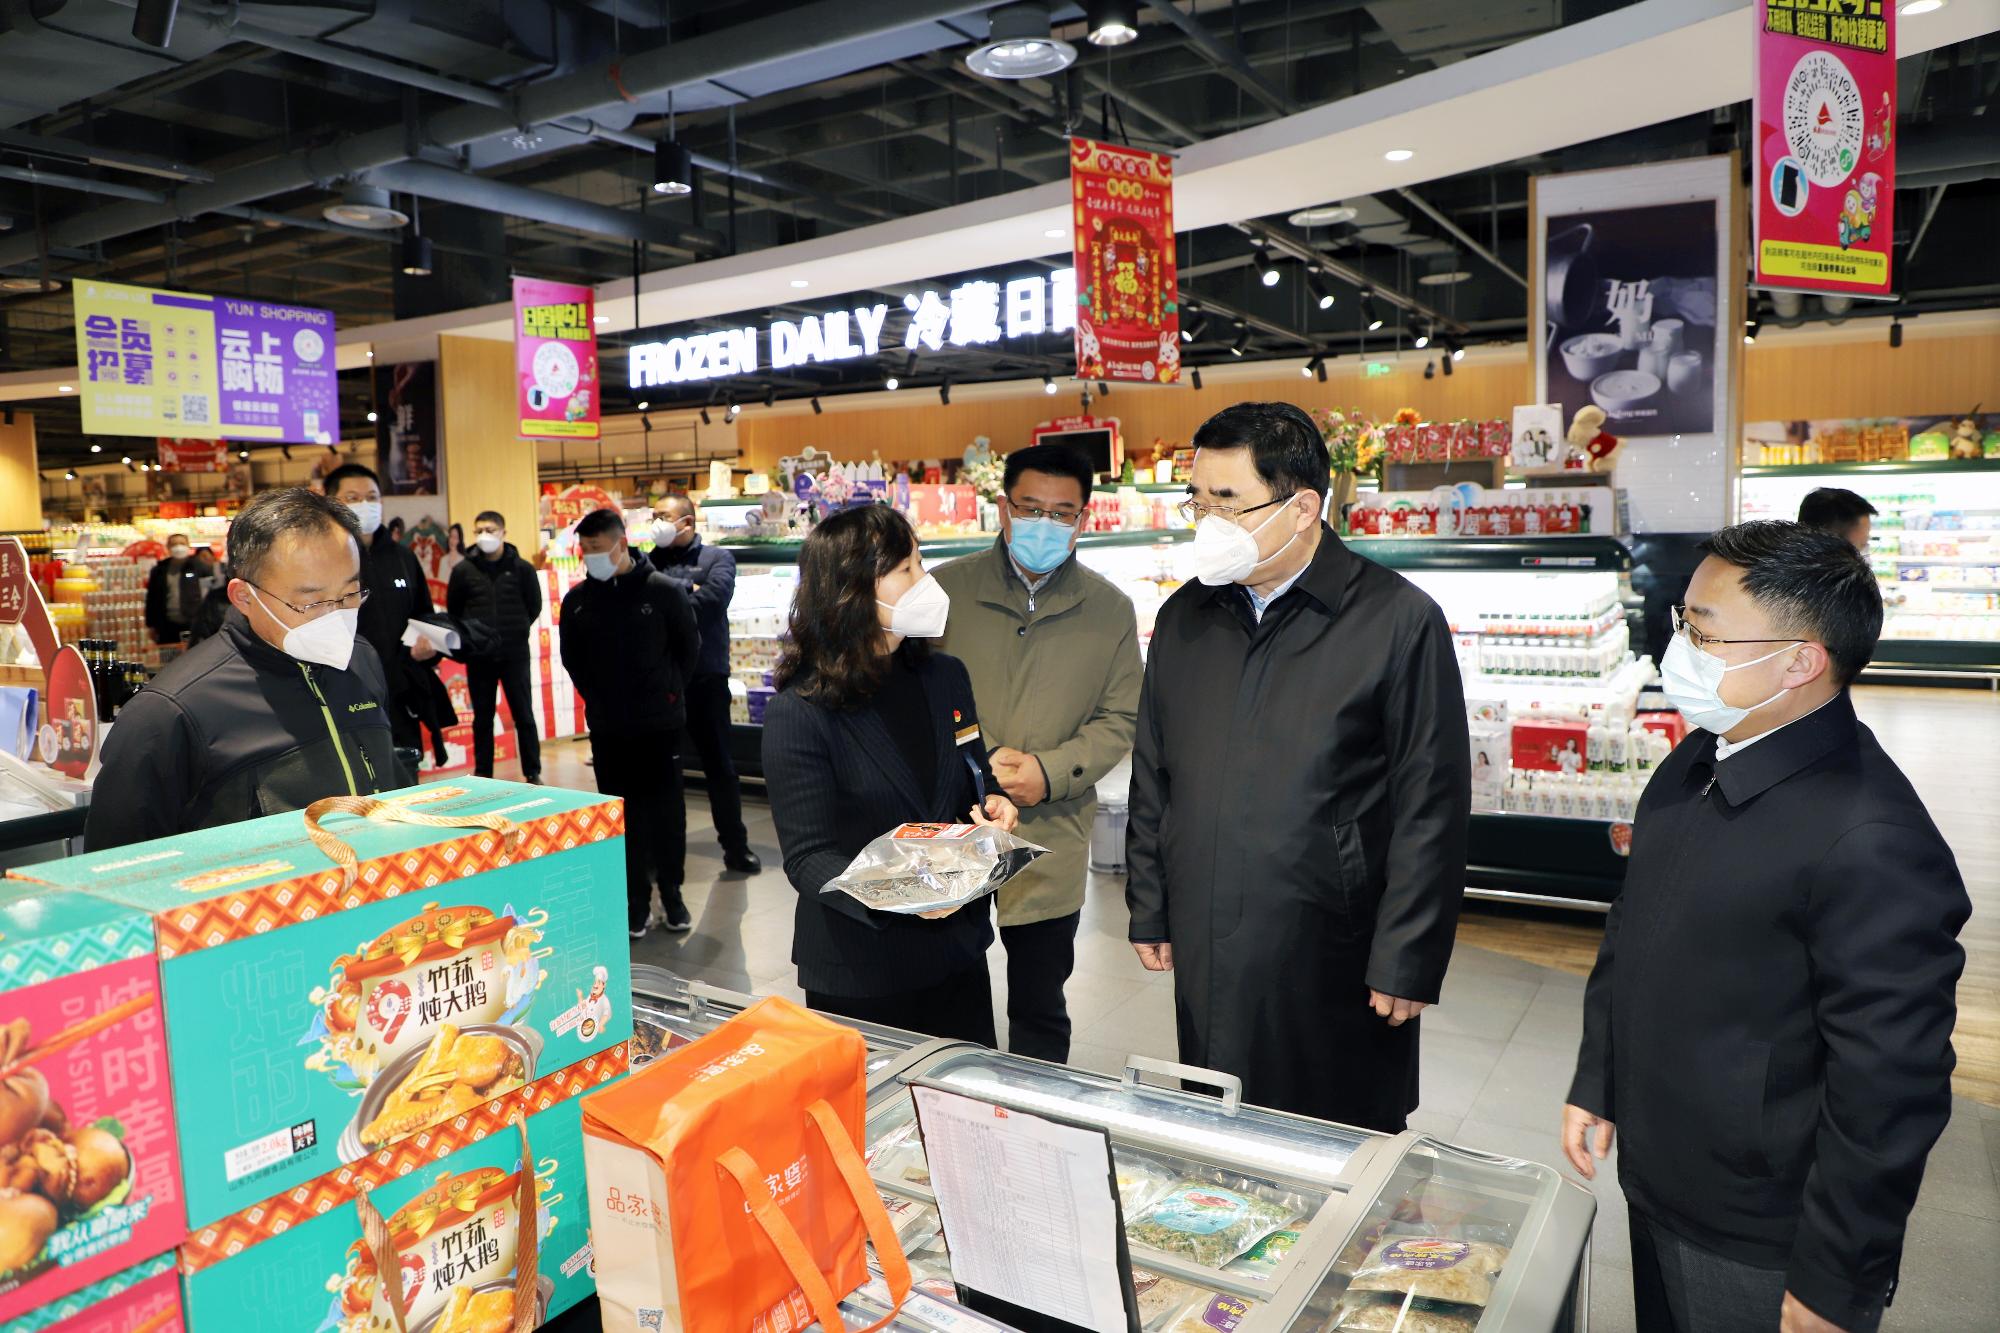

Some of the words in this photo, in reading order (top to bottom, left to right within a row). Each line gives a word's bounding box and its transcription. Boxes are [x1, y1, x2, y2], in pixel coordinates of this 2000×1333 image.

[225, 301, 254, 317] YUN
[260, 306, 327, 326] SHOPPING
[221, 328, 284, 365] 云上
[629, 326, 758, 388] FROZEN
[771, 303, 888, 369] DAILY
[222, 359, 285, 395] 购物
[427, 957, 475, 994] 竹荪
[418, 980, 488, 1027] 炖大鹅
[441, 1216, 487, 1260] 竹荪
[432, 1238, 500, 1295] 炖大鹅
